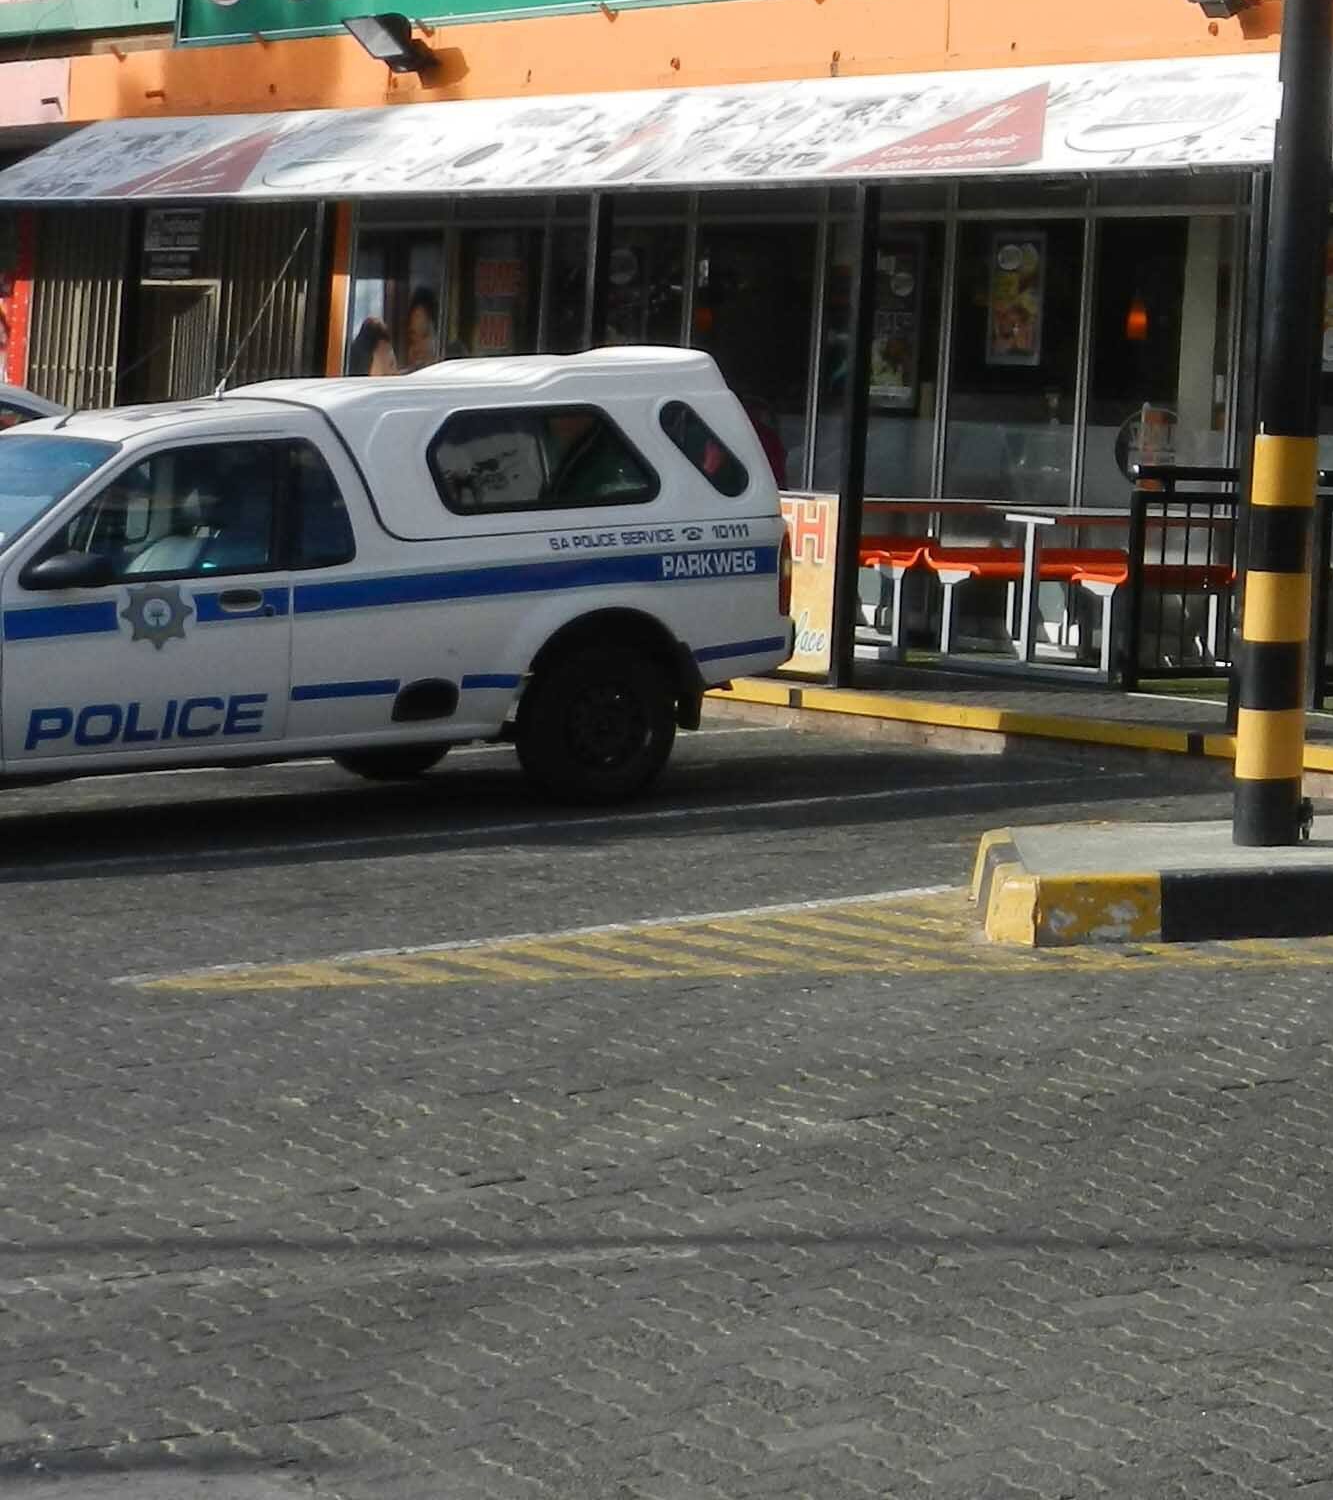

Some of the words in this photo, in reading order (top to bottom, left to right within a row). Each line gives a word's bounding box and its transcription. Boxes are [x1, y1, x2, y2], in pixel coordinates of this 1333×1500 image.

[549, 537, 570, 551] SA
[573, 532, 617, 549] POLICE
[620, 528, 676, 546] SERVICE
[711, 523, 750, 540] 10111
[661, 550, 757, 578] PARKWEG
[24, 693, 269, 751] POLICE
